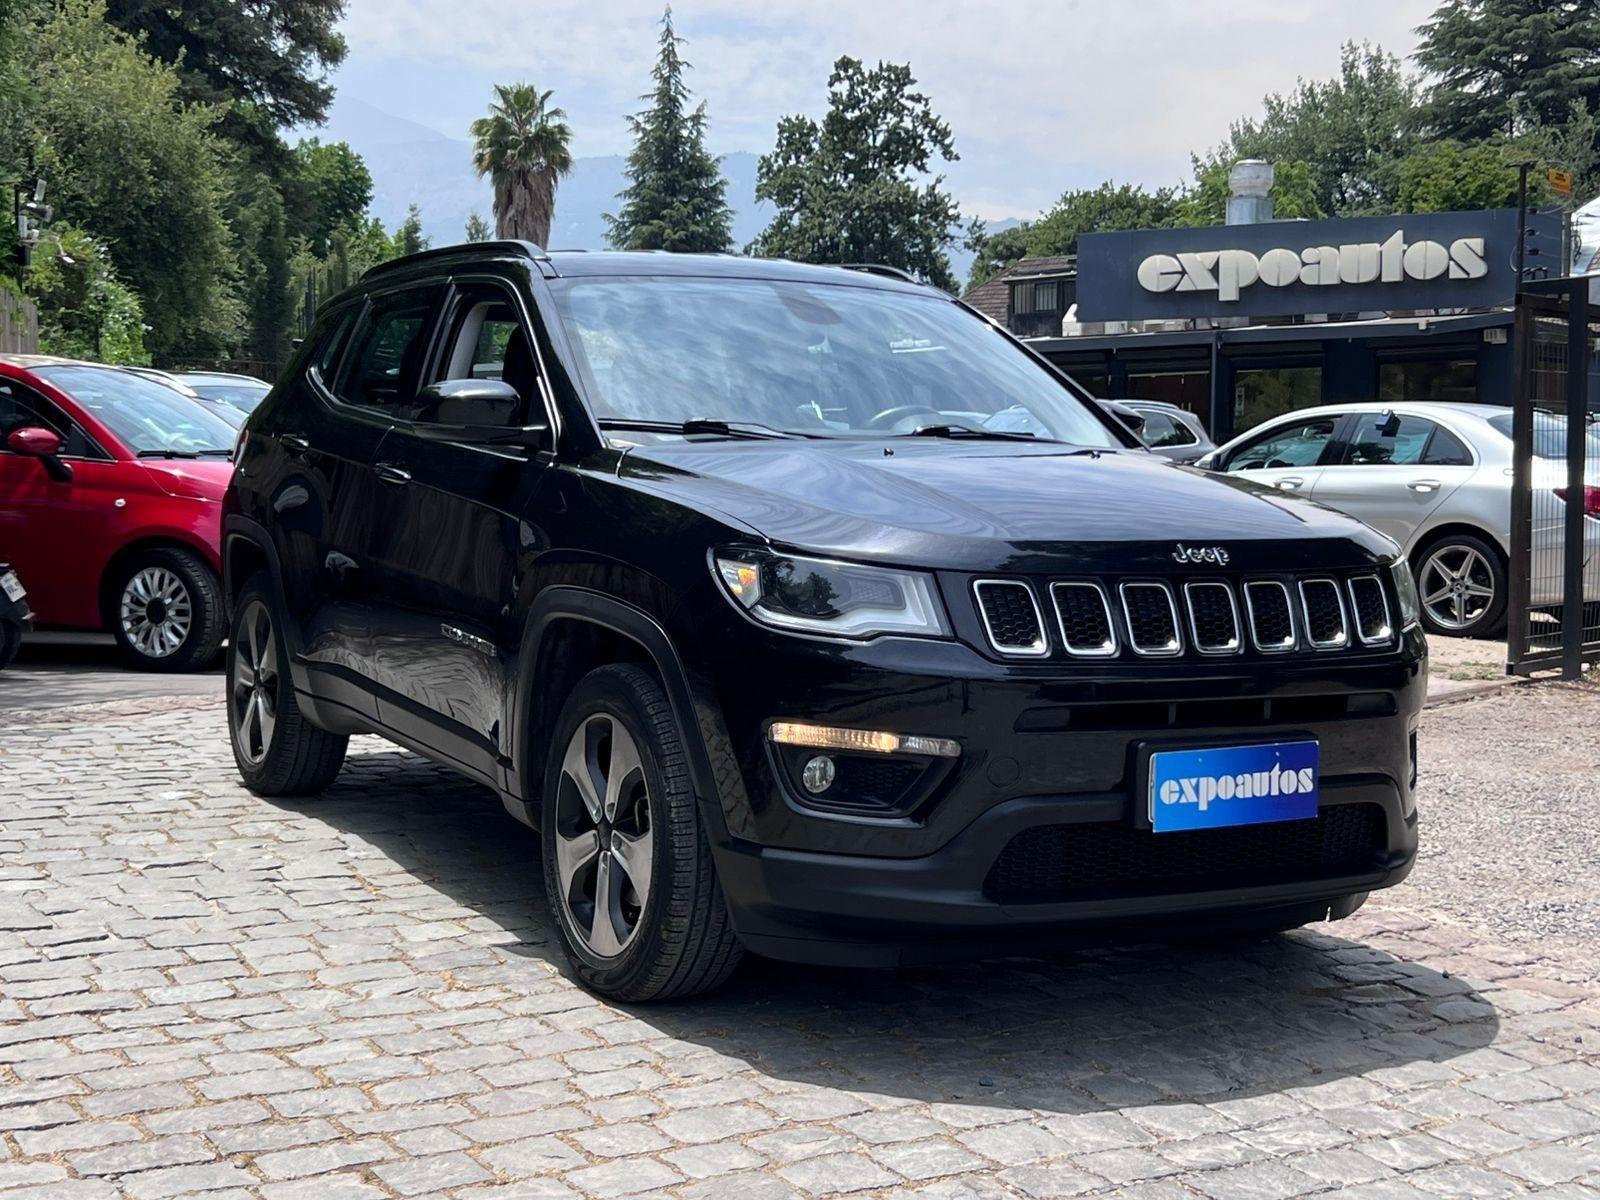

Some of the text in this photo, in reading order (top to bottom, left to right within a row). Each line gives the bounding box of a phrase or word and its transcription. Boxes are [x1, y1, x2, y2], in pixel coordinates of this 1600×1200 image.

[1137, 229, 1488, 301] expoautos
[1172, 543, 1230, 566] Jeep
[1159, 762, 1314, 811] expoautos
